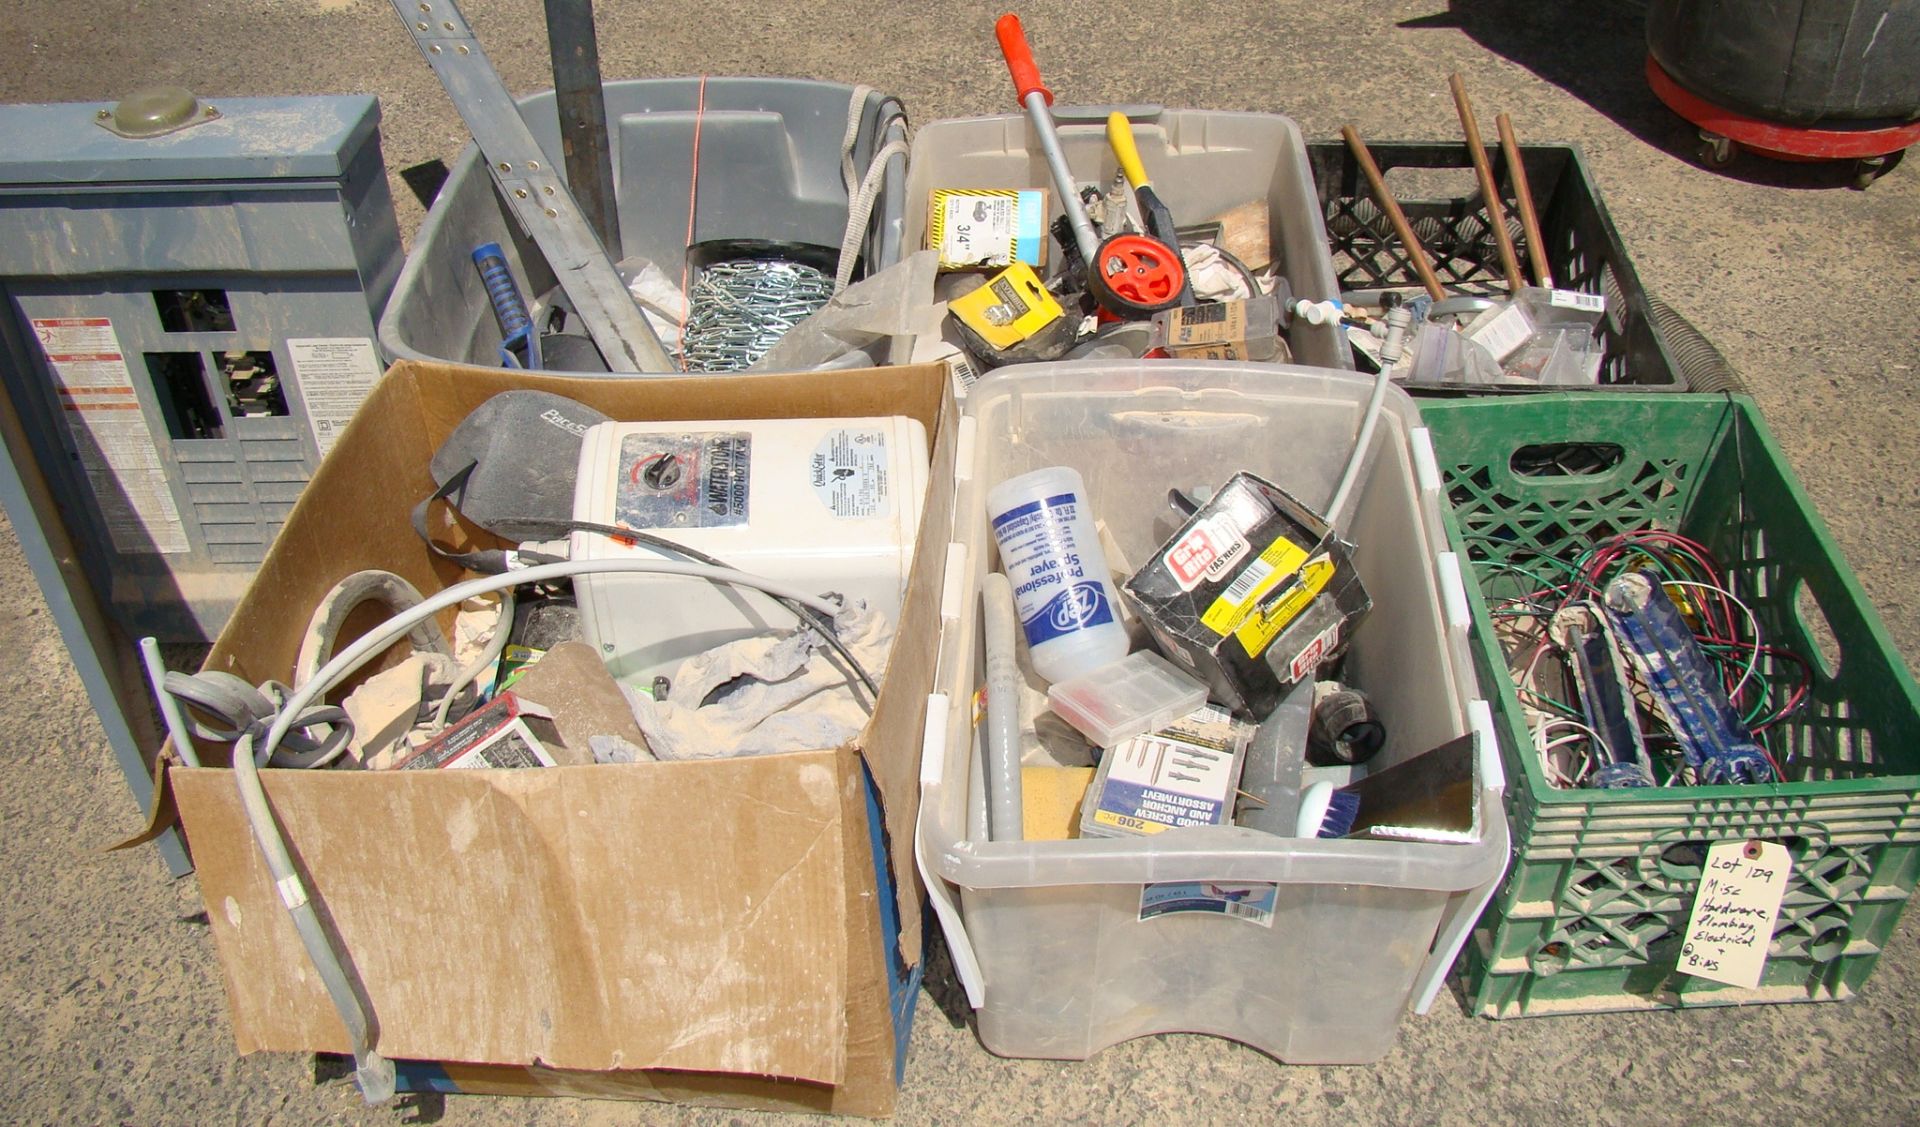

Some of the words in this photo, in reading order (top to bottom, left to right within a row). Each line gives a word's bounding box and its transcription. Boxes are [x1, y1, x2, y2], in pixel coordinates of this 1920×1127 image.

[956, 224, 971, 250] 3/4"
[541, 408, 588, 436] PaceS
[709, 438, 731, 503] WATERSTONE
[734, 463, 746, 484] HOT
[733, 485, 746, 515] #5000
[1174, 535, 1206, 564] Grip
[1030, 553, 1080, 576] Spayer
[1181, 546, 1214, 578] Rite
[1141, 789, 1215, 810] ASSORTMENT
[1143, 799, 1187, 815] ANCHOR
[1135, 808, 1174, 825] SCREW
[1189, 808, 1213, 820] AND
[1711, 857, 1743, 874] Lot
[1745, 868, 1774, 883] 109
[1704, 878, 1741, 896] Misc
[1693, 931, 1756, 948] Electrical
